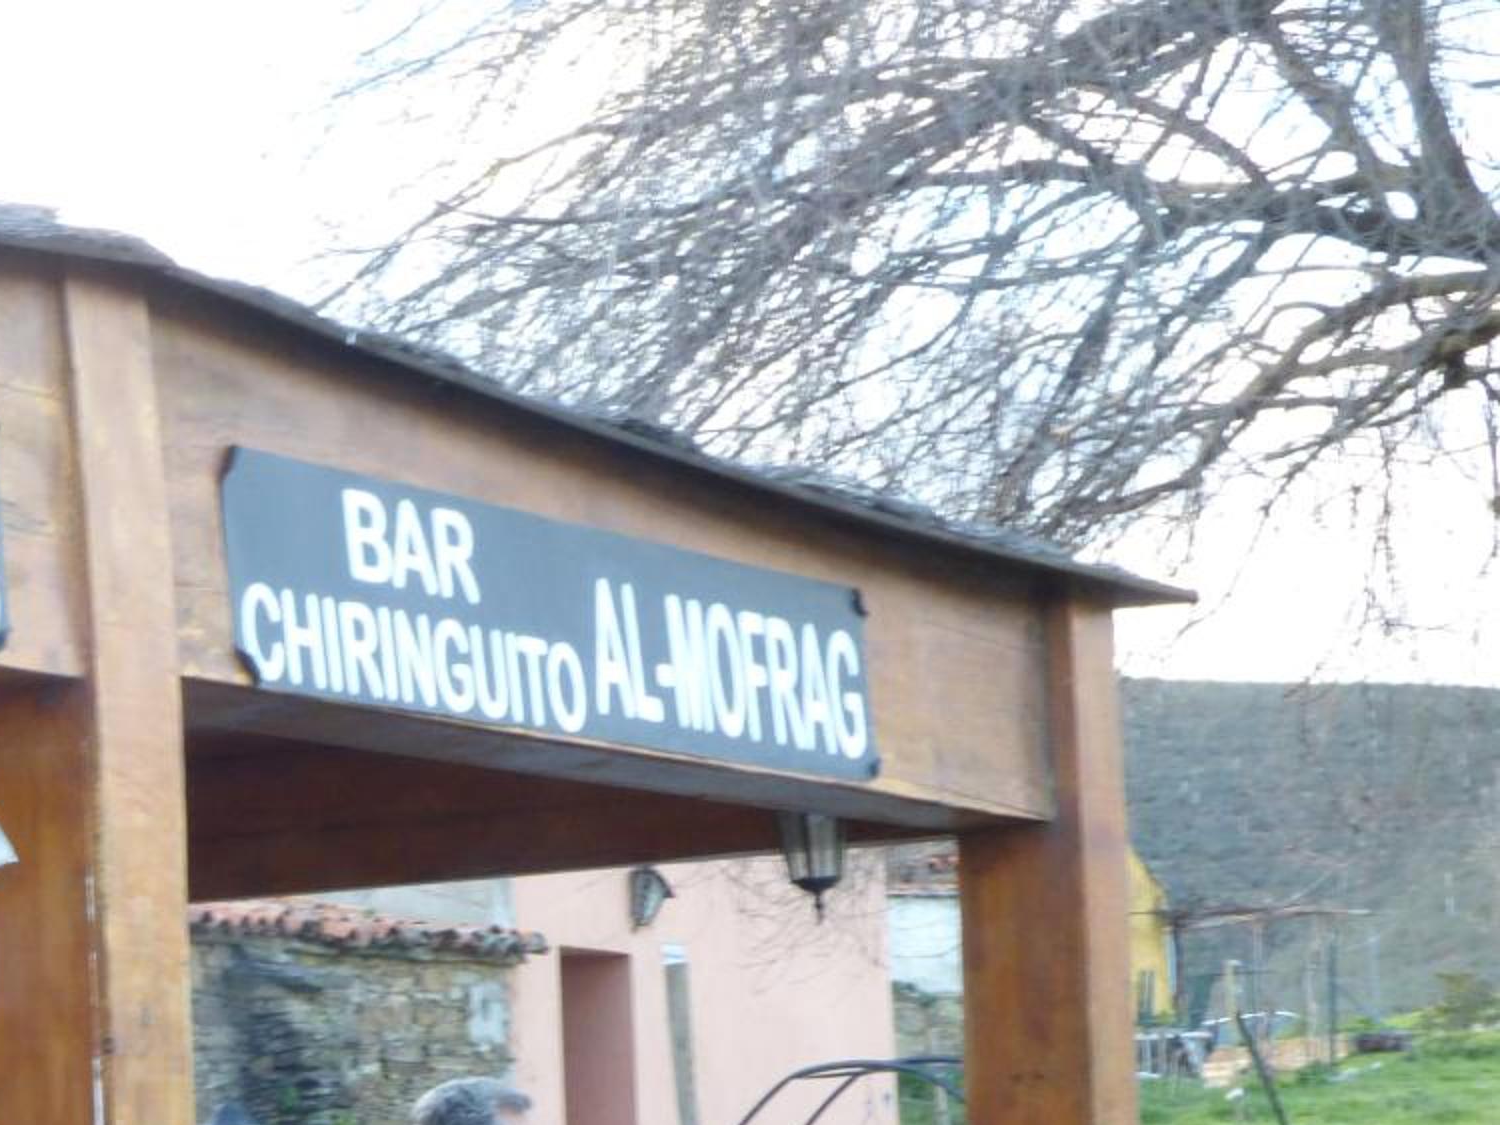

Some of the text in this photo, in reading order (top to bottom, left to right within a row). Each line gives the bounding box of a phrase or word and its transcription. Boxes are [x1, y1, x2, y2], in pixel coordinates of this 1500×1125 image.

[341, 488, 481, 604] BAR
[240, 576, 868, 760] CHIRINGUITO AL-MOFRAG
